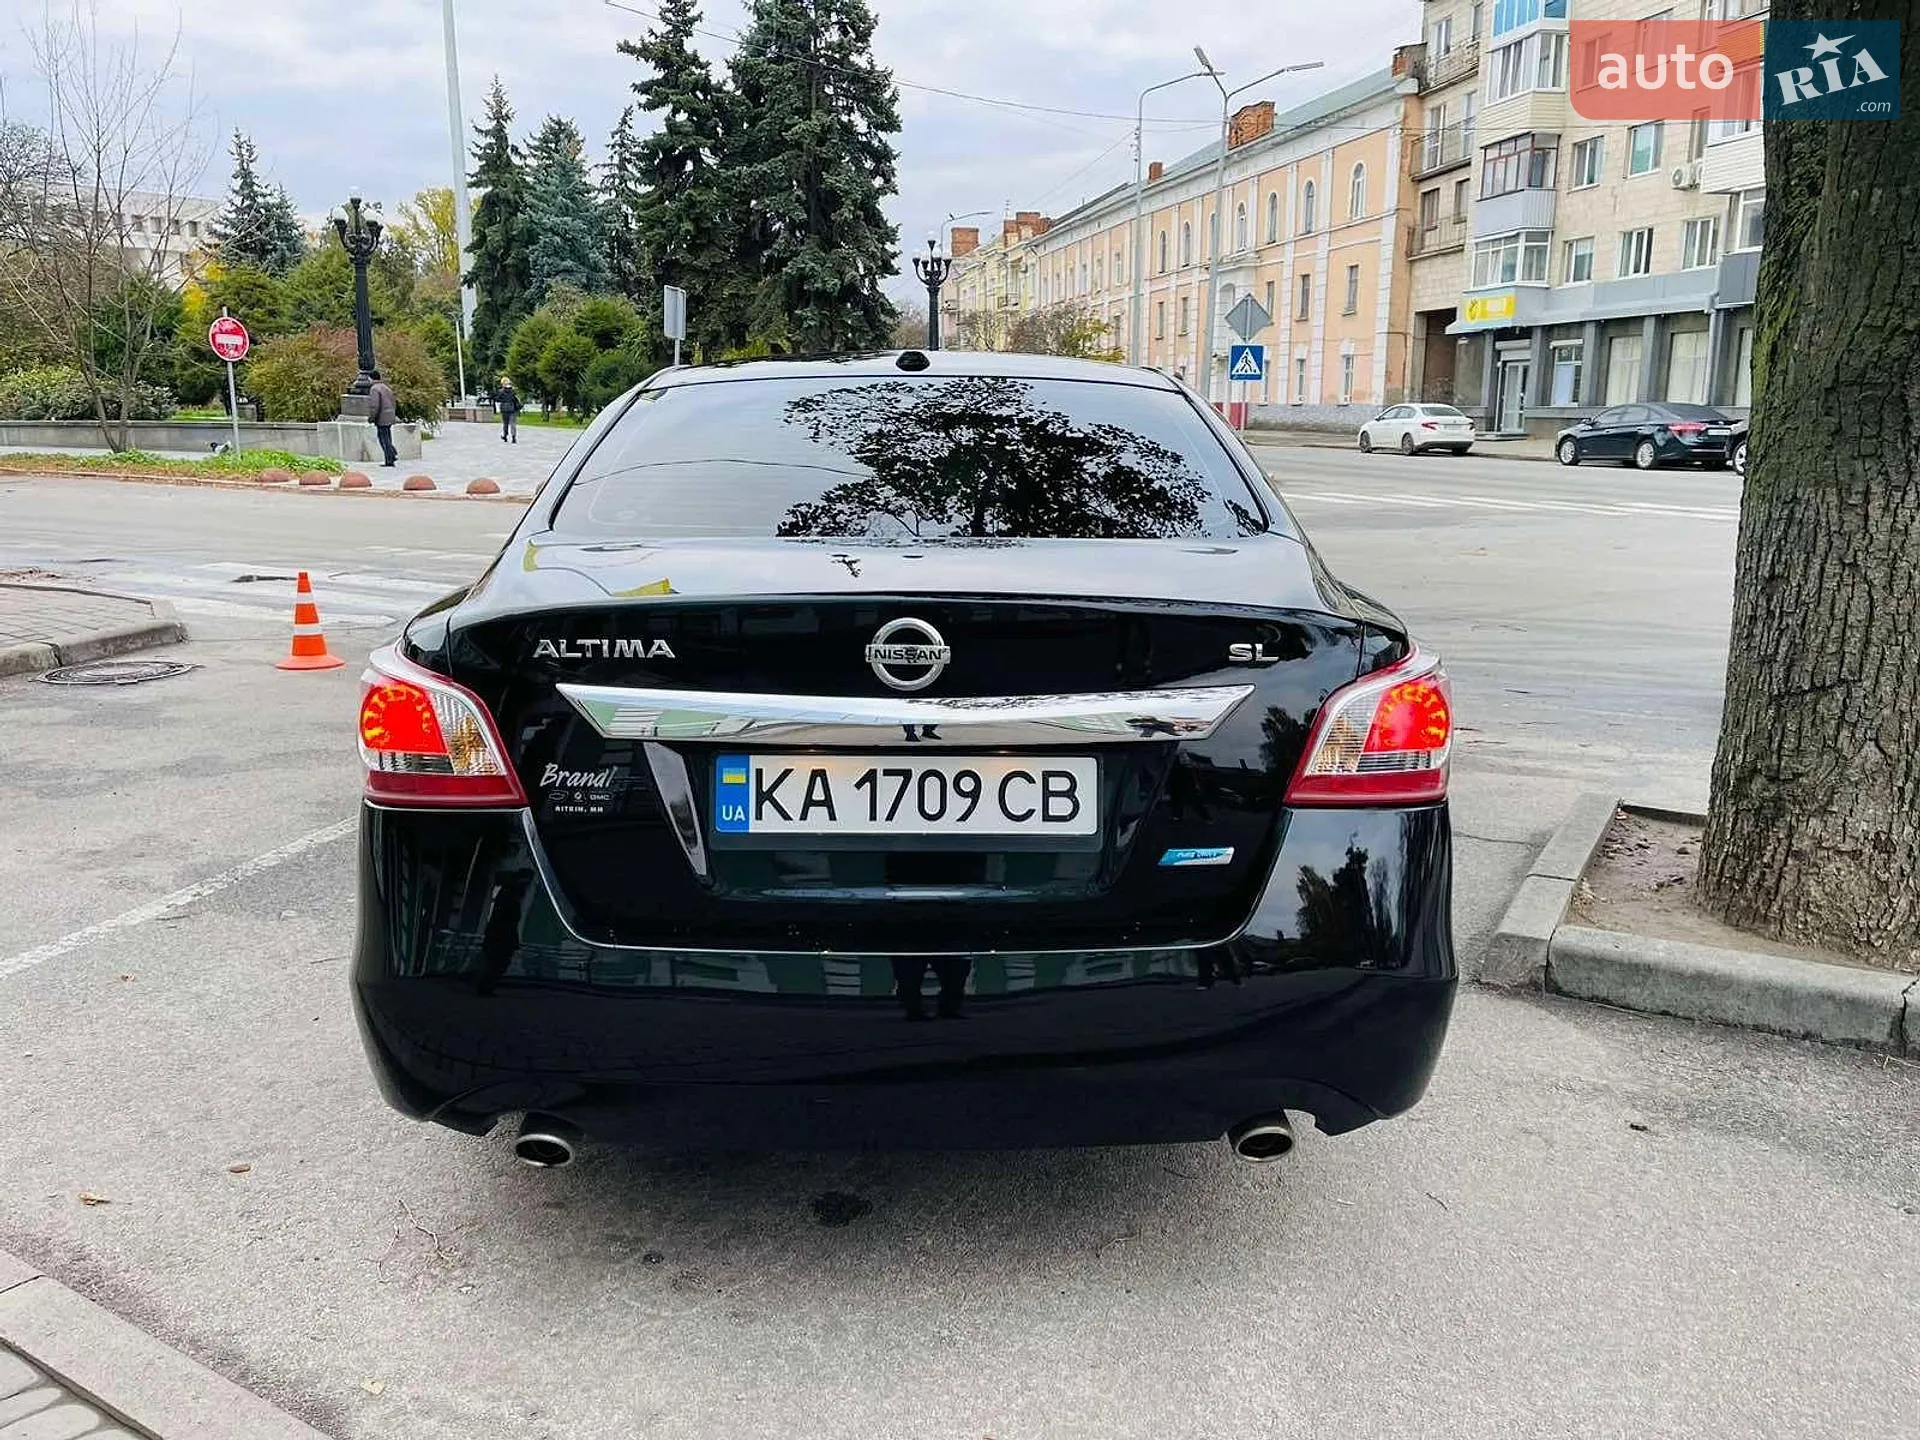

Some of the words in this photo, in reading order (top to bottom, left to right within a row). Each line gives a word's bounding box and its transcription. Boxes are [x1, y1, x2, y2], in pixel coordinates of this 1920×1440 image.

[533, 638, 676, 659] ALTIMA
[873, 647, 942, 661] NISSAN
[1228, 643, 1280, 661] SL
[754, 767, 837, 822] KA
[854, 768, 983, 822] 1709
[998, 769, 1081, 822] CB
[722, 805, 746, 822] UA
